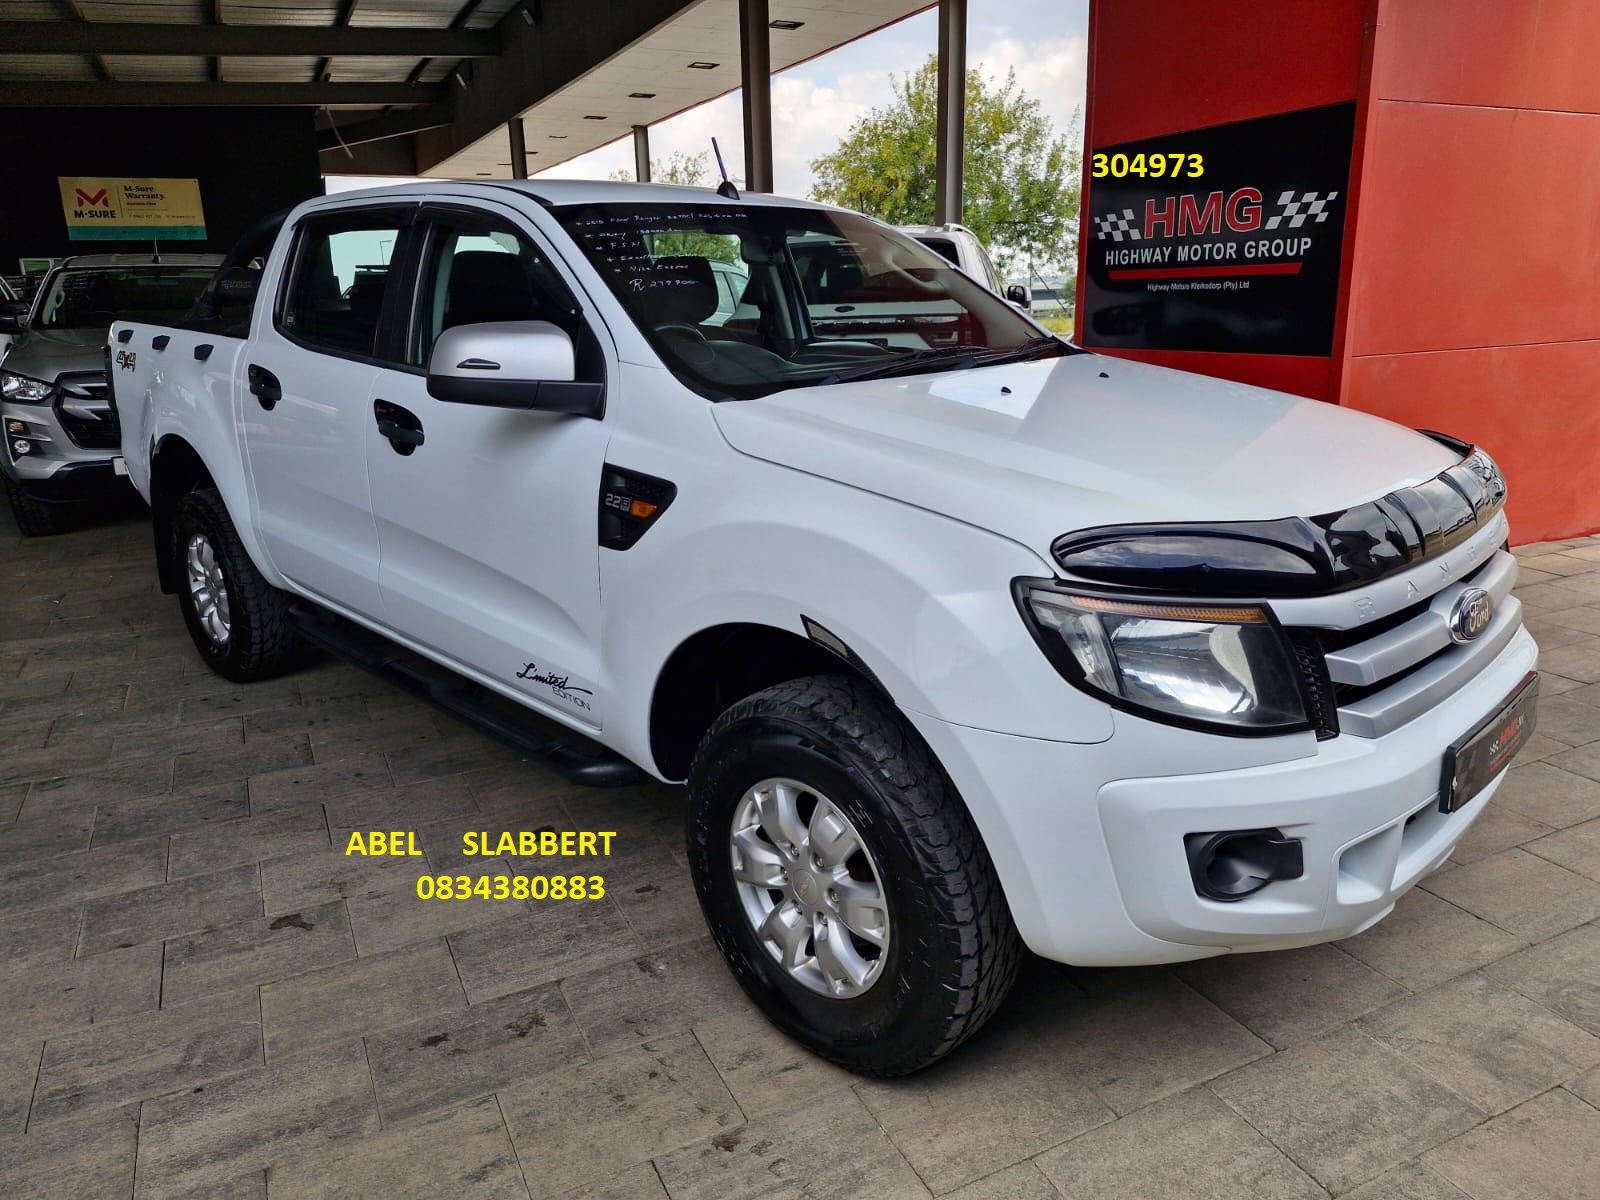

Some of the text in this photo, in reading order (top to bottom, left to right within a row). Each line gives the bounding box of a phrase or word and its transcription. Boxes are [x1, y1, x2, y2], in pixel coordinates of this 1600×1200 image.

[1143, 187, 1263, 239] HMG
[1105, 237, 1312, 266] HIGHWAY MOTOR GROUP
[1147, 284, 1170, 292] Highway
[1171, 282, 1190, 290] Motors
[1223, 281, 1238, 291] (Pty)
[1239, 281, 1250, 289] Ltd
[1469, 600, 1491, 632] Ford
[516, 662, 593, 695] Limited
[551, 685, 592, 711] EDITION
